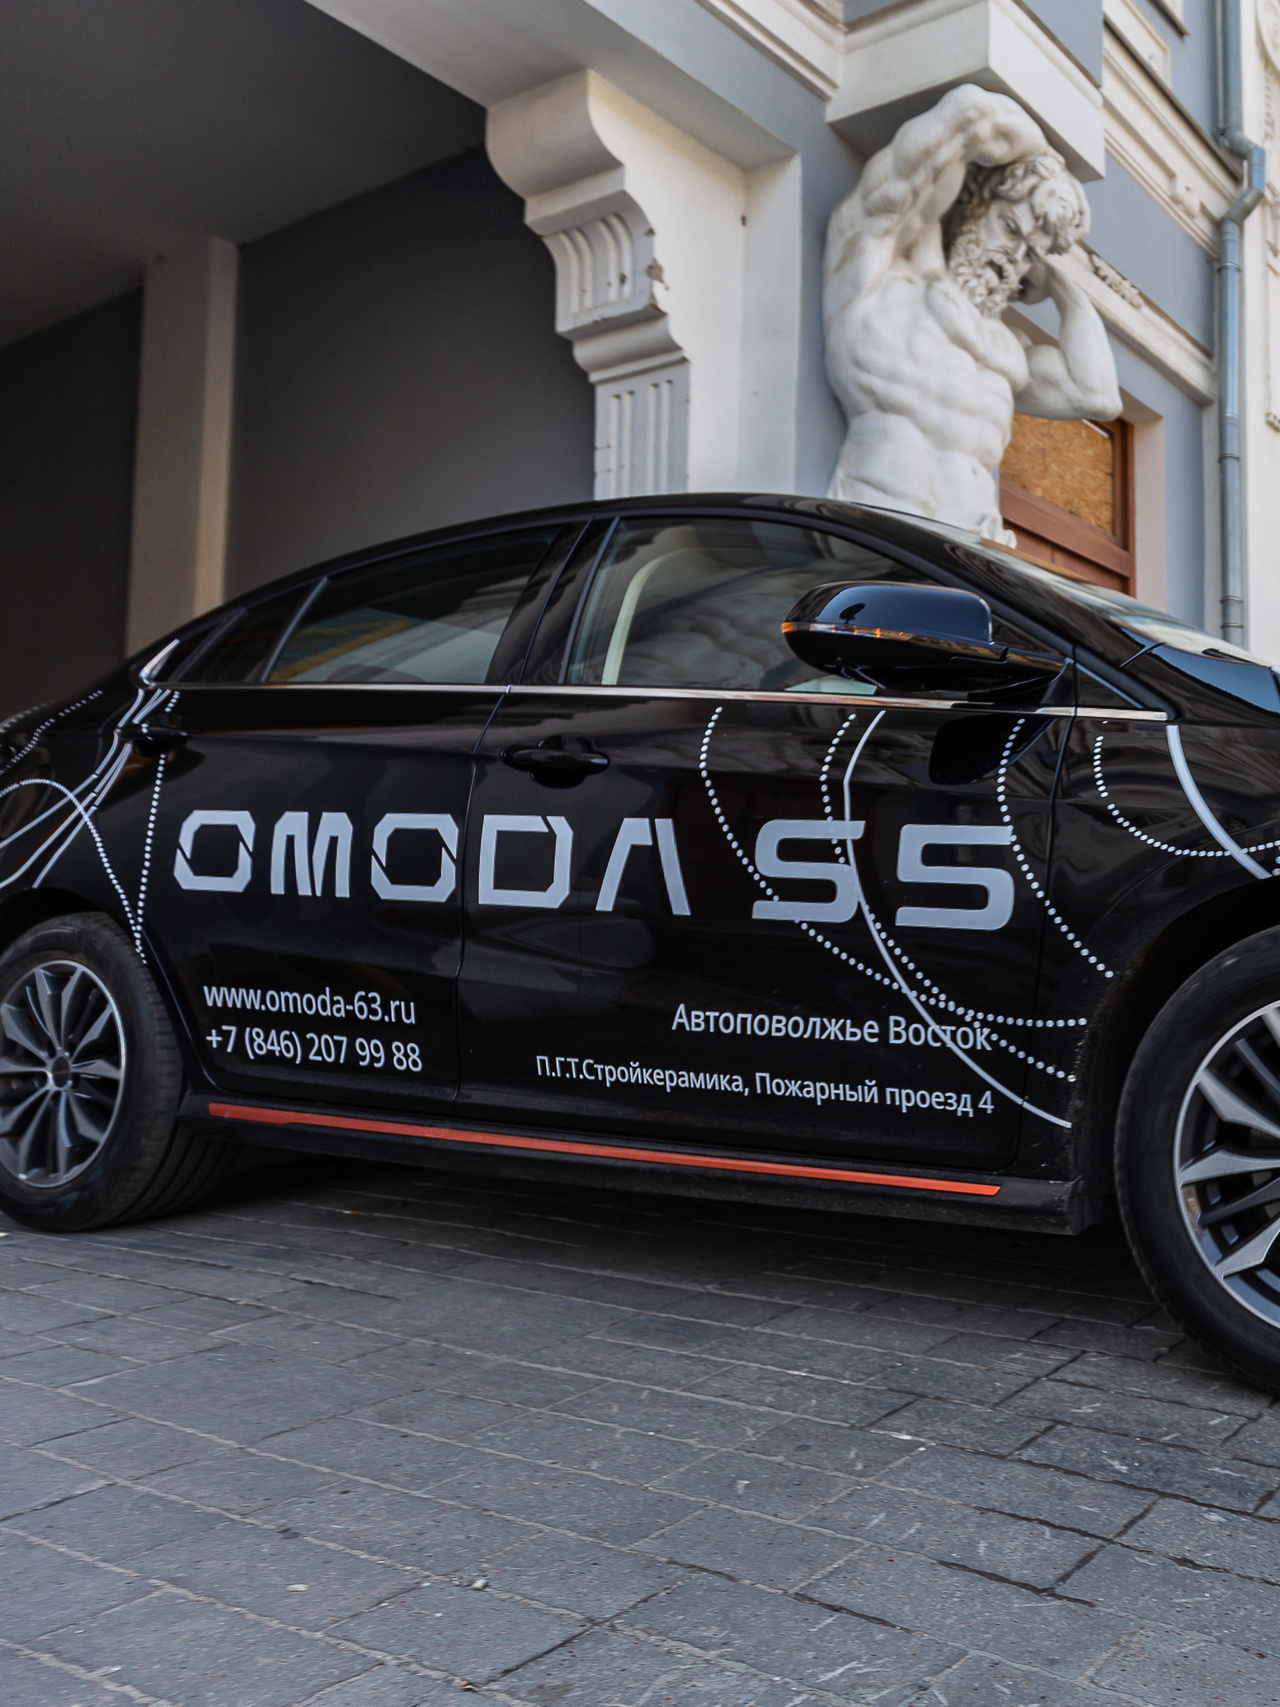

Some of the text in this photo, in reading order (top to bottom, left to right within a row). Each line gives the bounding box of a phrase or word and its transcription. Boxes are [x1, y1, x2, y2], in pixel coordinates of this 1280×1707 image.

[173, 809, 691, 916] OMODA
[203, 986, 416, 1024] www.omoda-63.ru
[671, 1003, 992, 1051] Автоповолжье Восток
[205, 1025, 423, 1072] +7 (846) 207 99 88
[536, 1055, 995, 1118] П.Г.Т.Стройкерамика, Пожарный проезд 4
